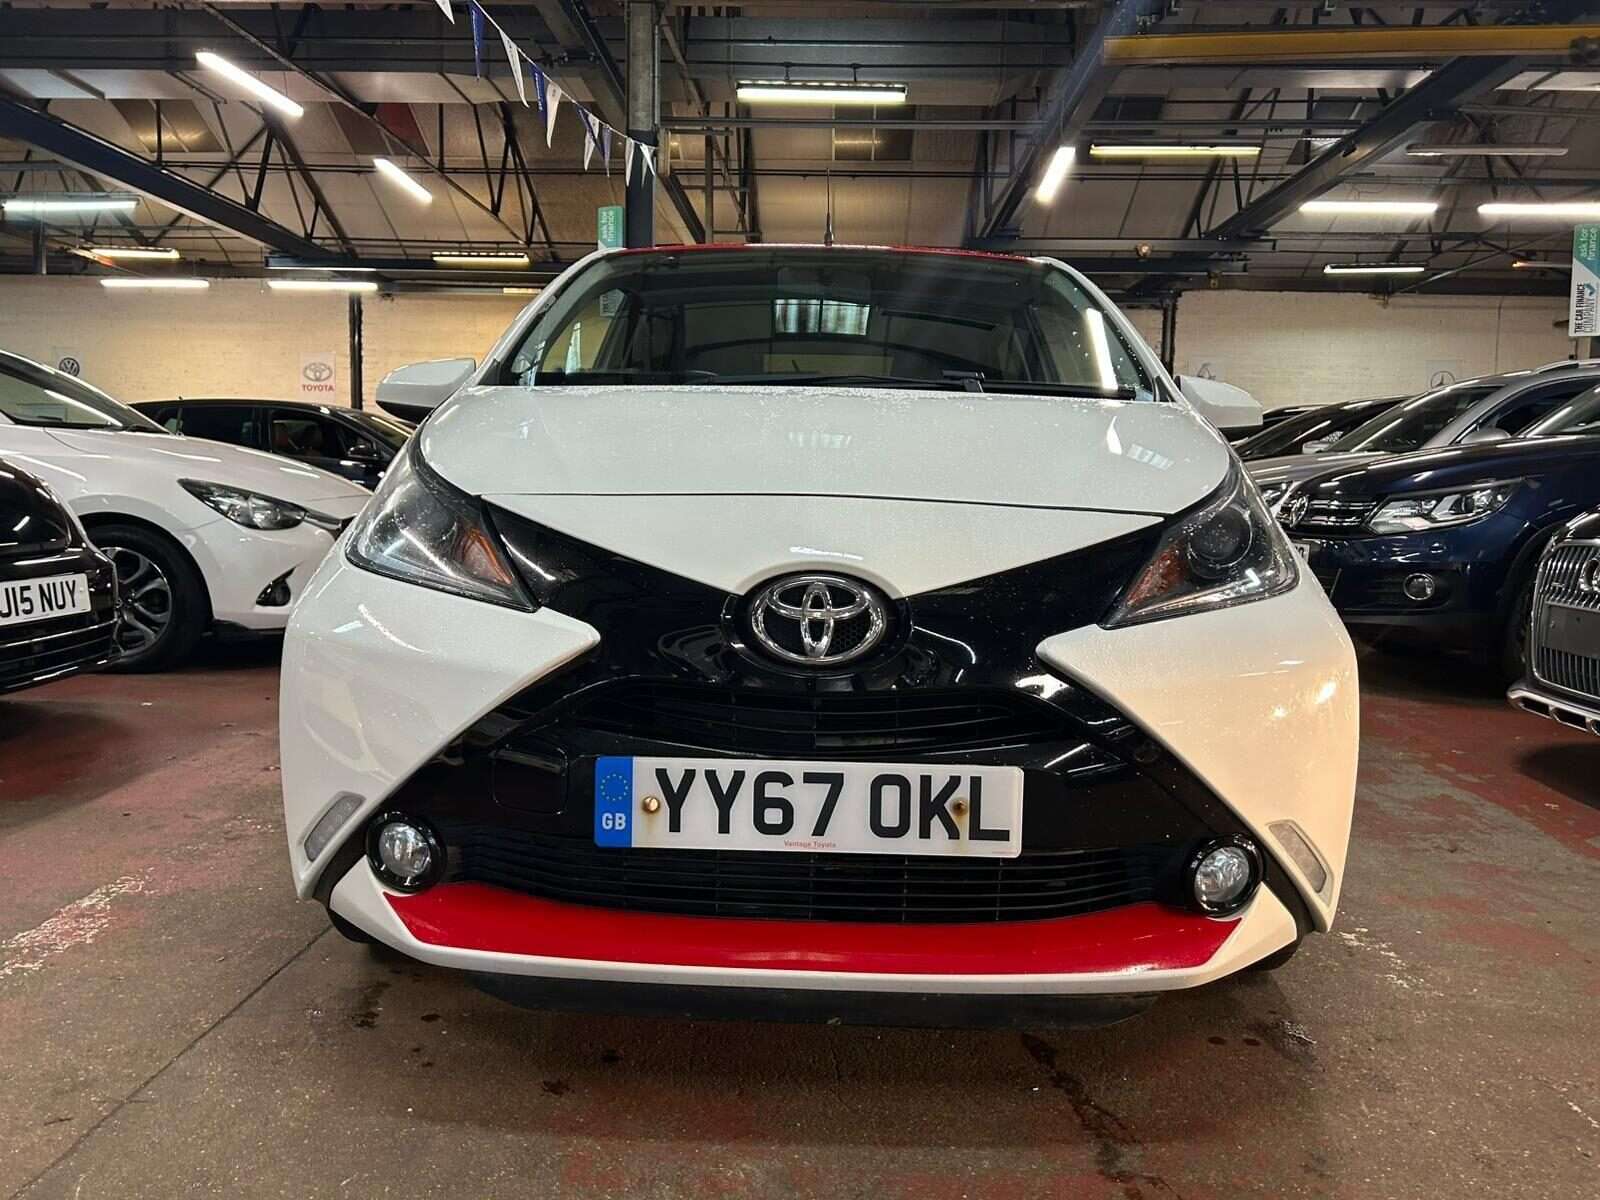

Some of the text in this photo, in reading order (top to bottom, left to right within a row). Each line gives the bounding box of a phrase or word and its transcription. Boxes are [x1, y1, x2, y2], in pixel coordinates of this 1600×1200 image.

[1574, 283, 1585, 334] THE CAR FINANCE
[1584, 297, 1595, 333] COMPANY
[302, 384, 334, 392] TOYOTA
[38, 580, 76, 612] NUY
[655, 767, 1011, 842] YY67 OKL
[602, 812, 626, 830] GB
[784, 839, 836, 850] Vantage Toyota
